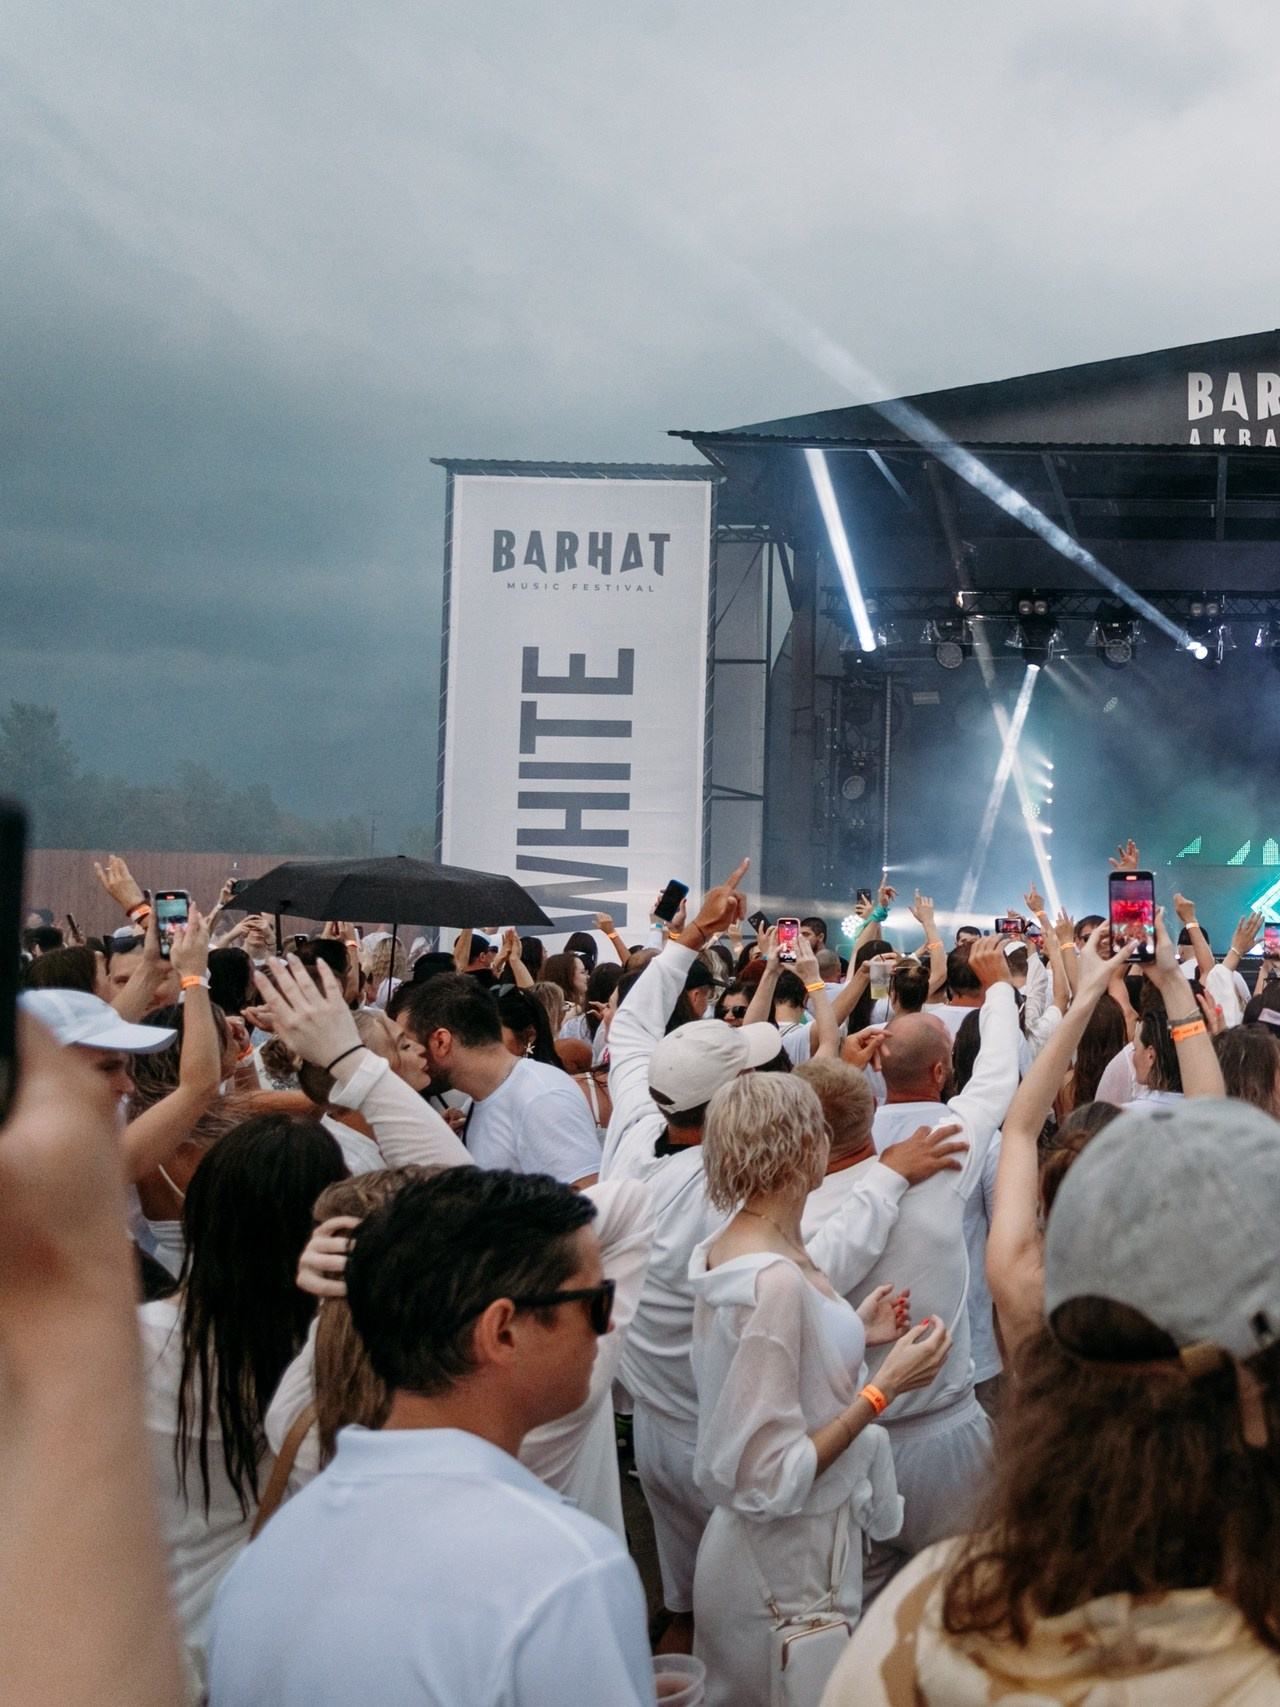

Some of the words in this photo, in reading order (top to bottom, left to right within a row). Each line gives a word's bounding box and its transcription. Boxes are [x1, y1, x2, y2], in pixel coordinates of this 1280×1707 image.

[493, 529, 671, 577] BARHAT
[507, 582, 560, 591] MUSIC
[572, 583, 654, 593] FESTIVAL
[516, 646, 635, 936] WHITE
